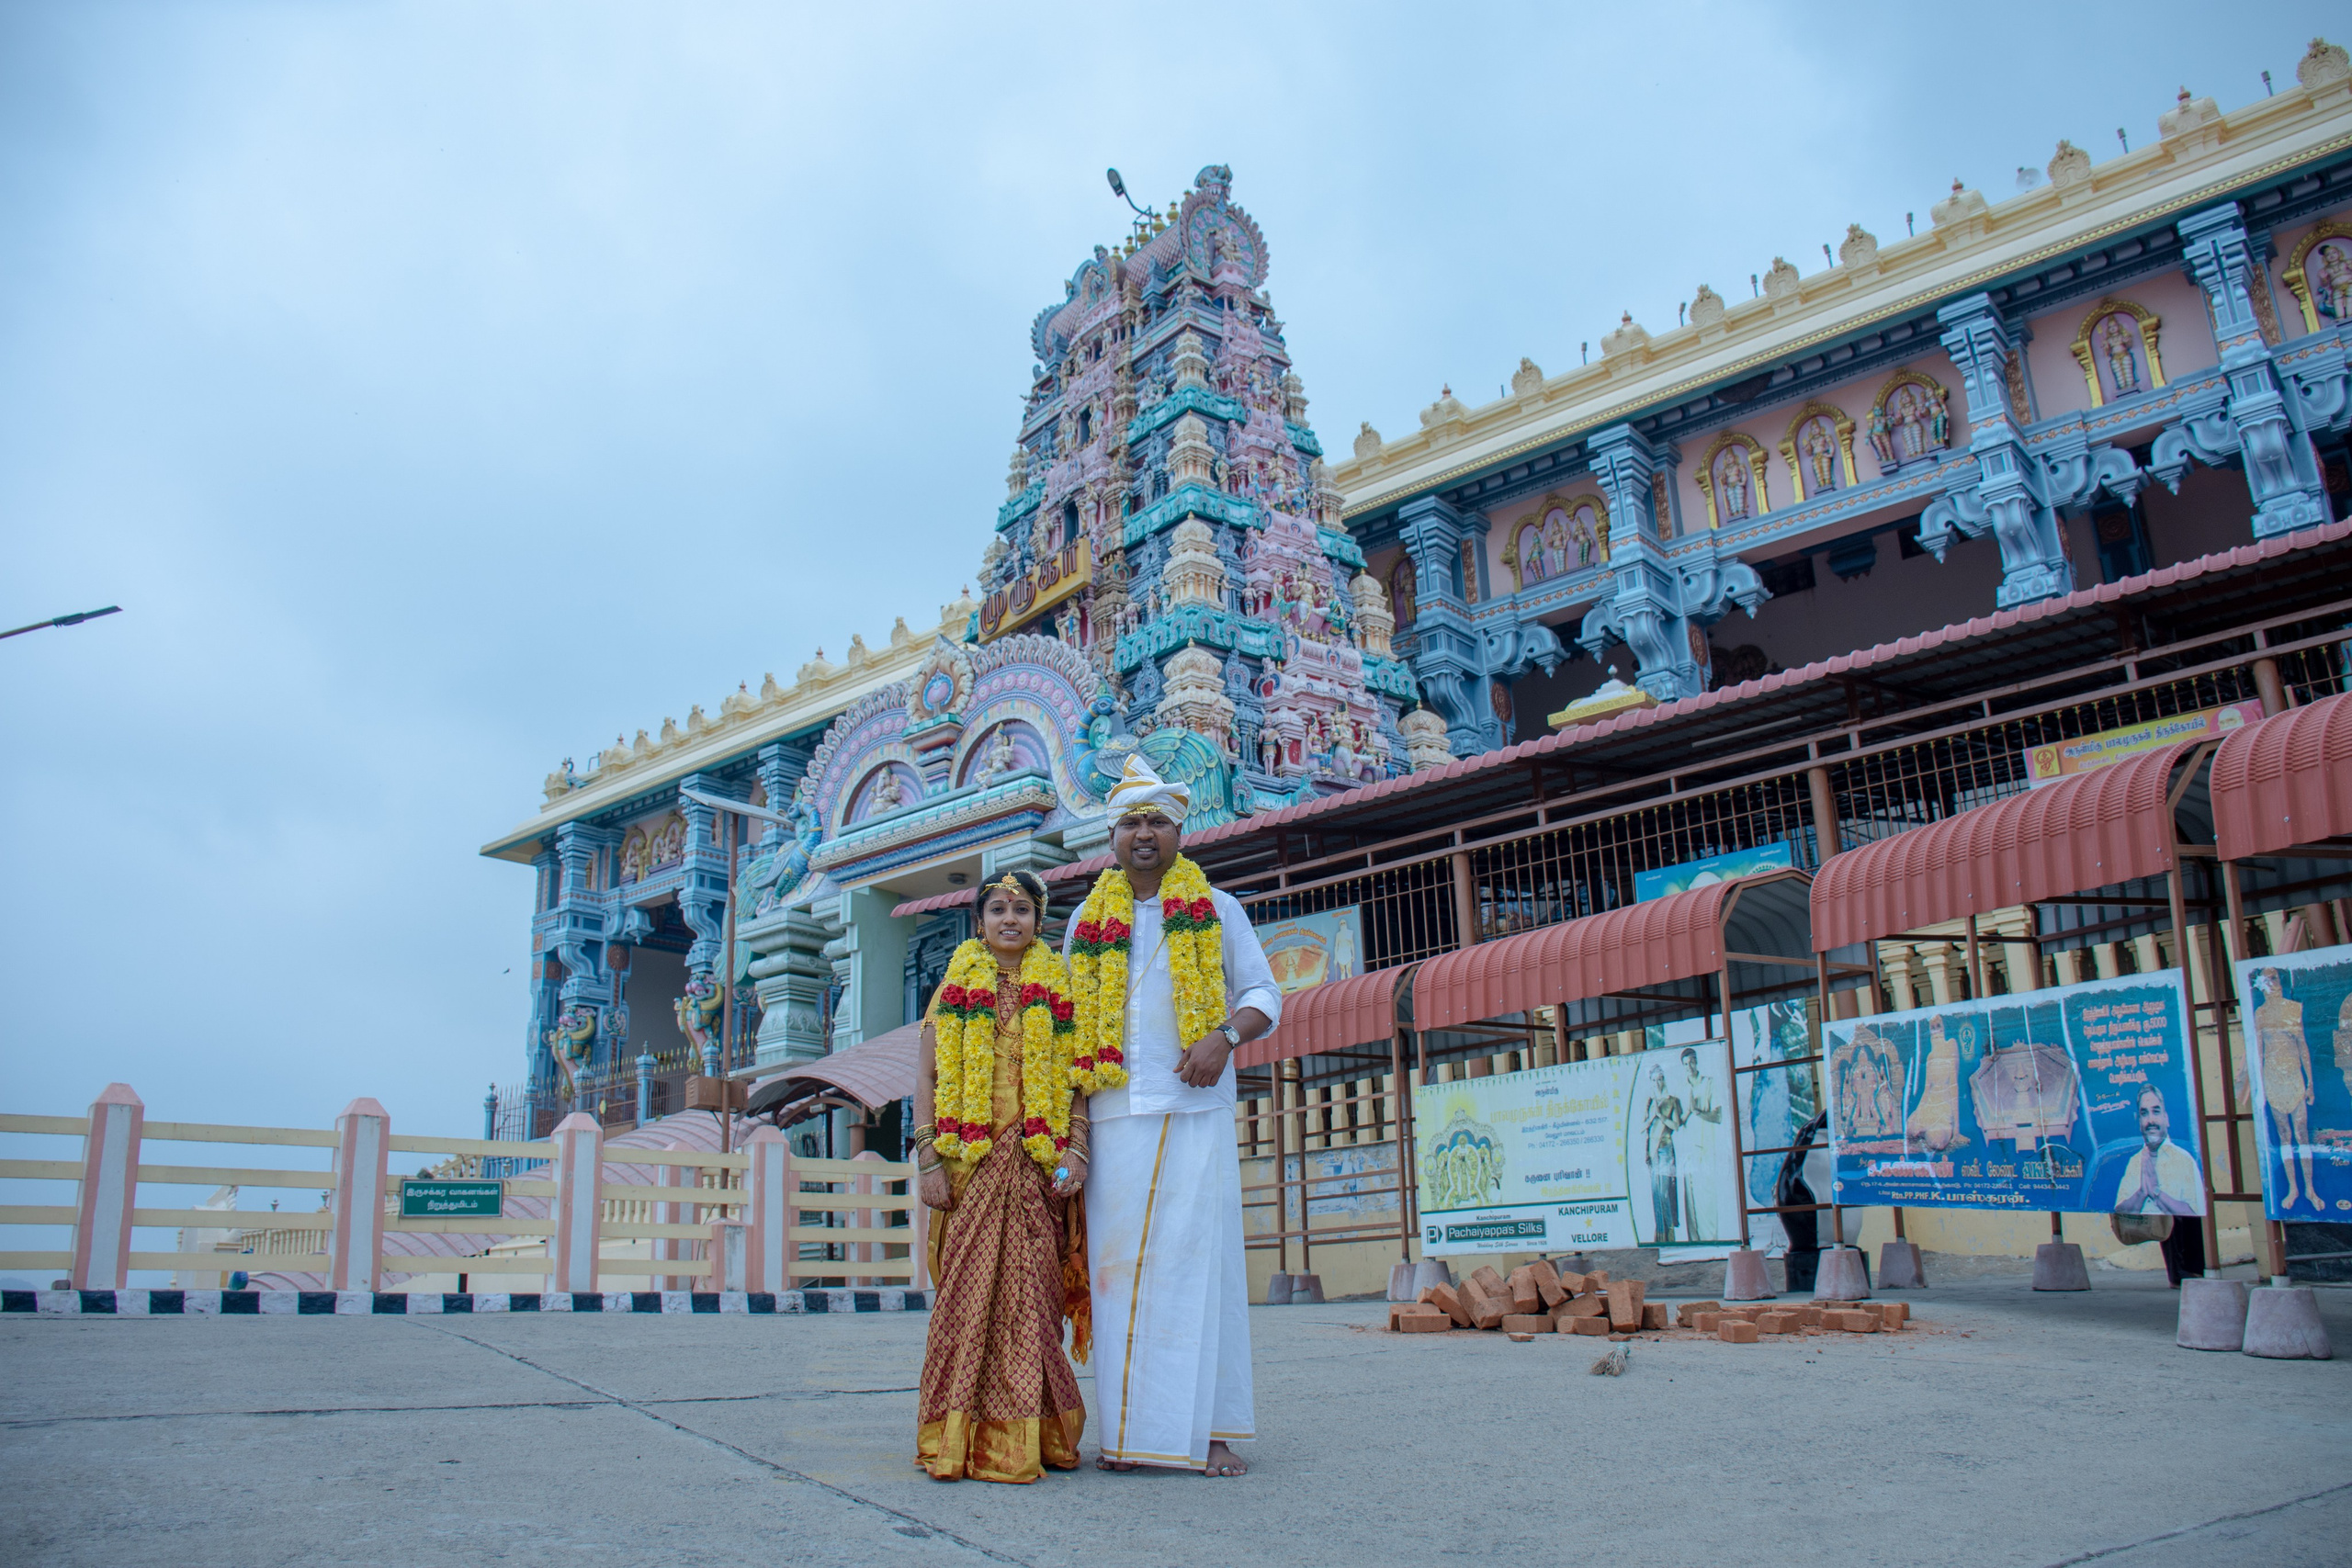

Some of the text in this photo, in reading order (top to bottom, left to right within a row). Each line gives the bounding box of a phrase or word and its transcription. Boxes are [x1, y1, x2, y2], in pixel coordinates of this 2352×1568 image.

[980, 544, 1078, 635] முருகா
[2106, 728, 2152, 750] பாலமுருகன்
[406, 1187, 499, 1197] இருசக்கர வாகனங்கள்
[427, 1200, 478, 1211] நிறுத்துமிடம்
[1558, 1204, 1618, 1215] KANCHIPURAM
[1448, 1224, 1515, 1238] Pachaiyappa's
[1518, 1223, 1543, 1234] Silks
[1571, 1233, 1608, 1243] VELLORE
